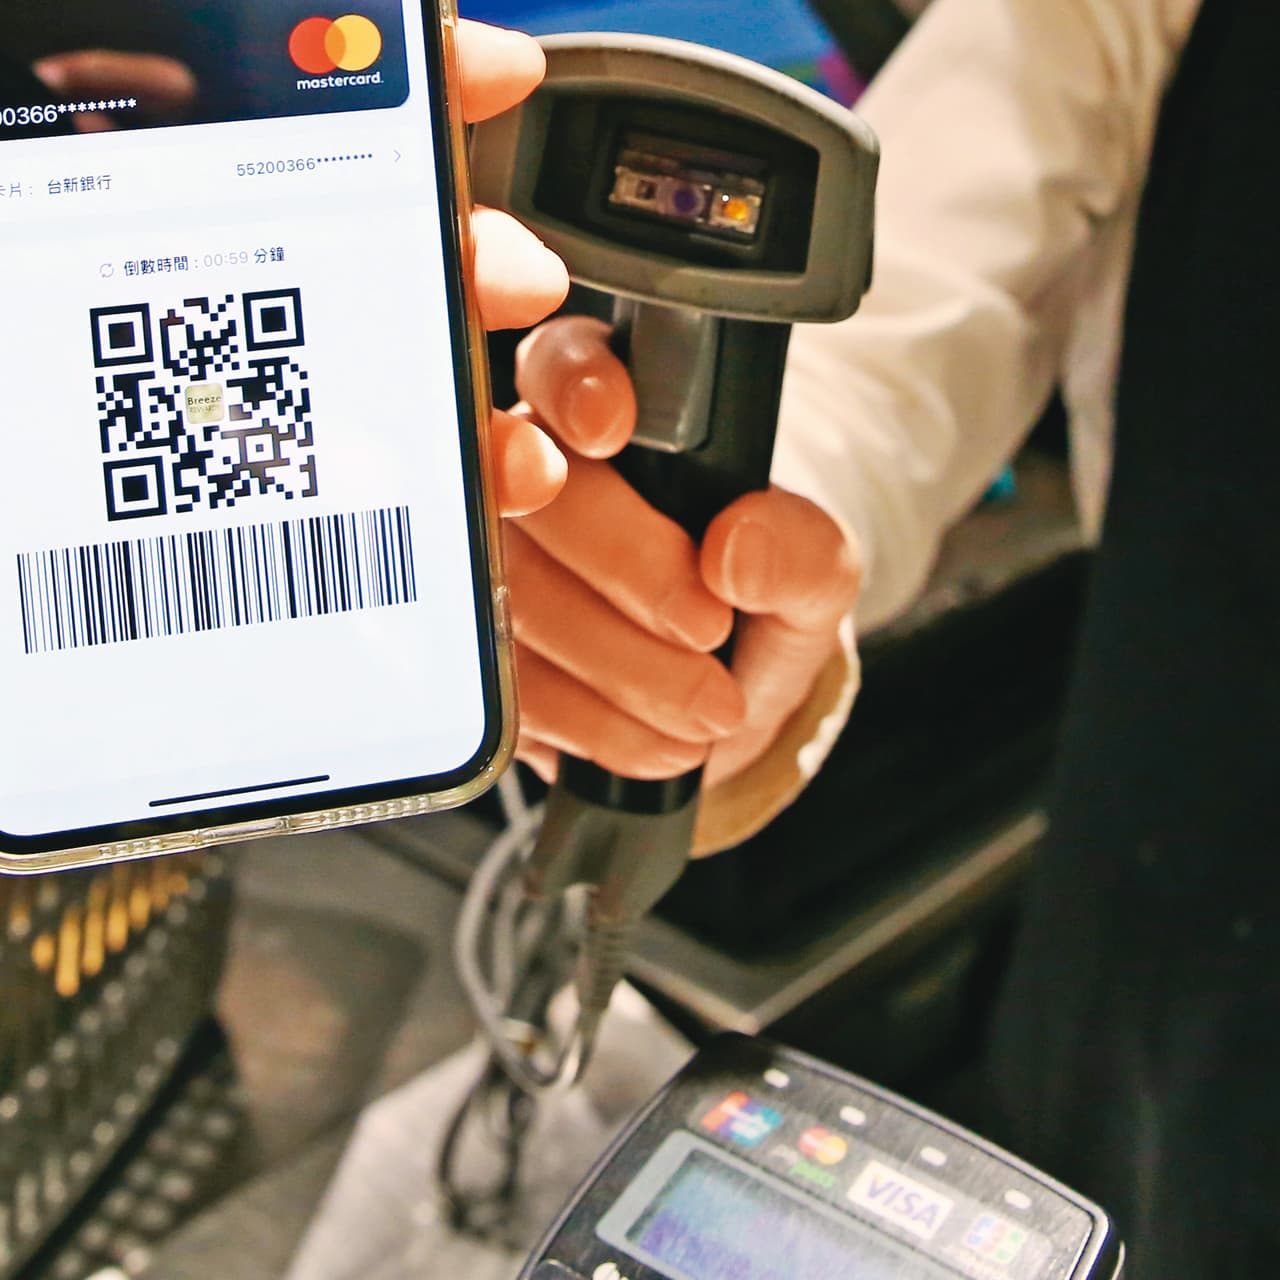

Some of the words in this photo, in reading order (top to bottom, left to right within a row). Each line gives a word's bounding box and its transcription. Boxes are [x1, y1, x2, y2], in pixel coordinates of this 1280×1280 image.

[296, 71, 382, 90] mastercard
[47, 174, 113, 195] 台新銀行
[203, 250, 249, 269] 00:59
[253, 246, 285, 264] 分鐘
[866, 1170, 942, 1231] VISA
